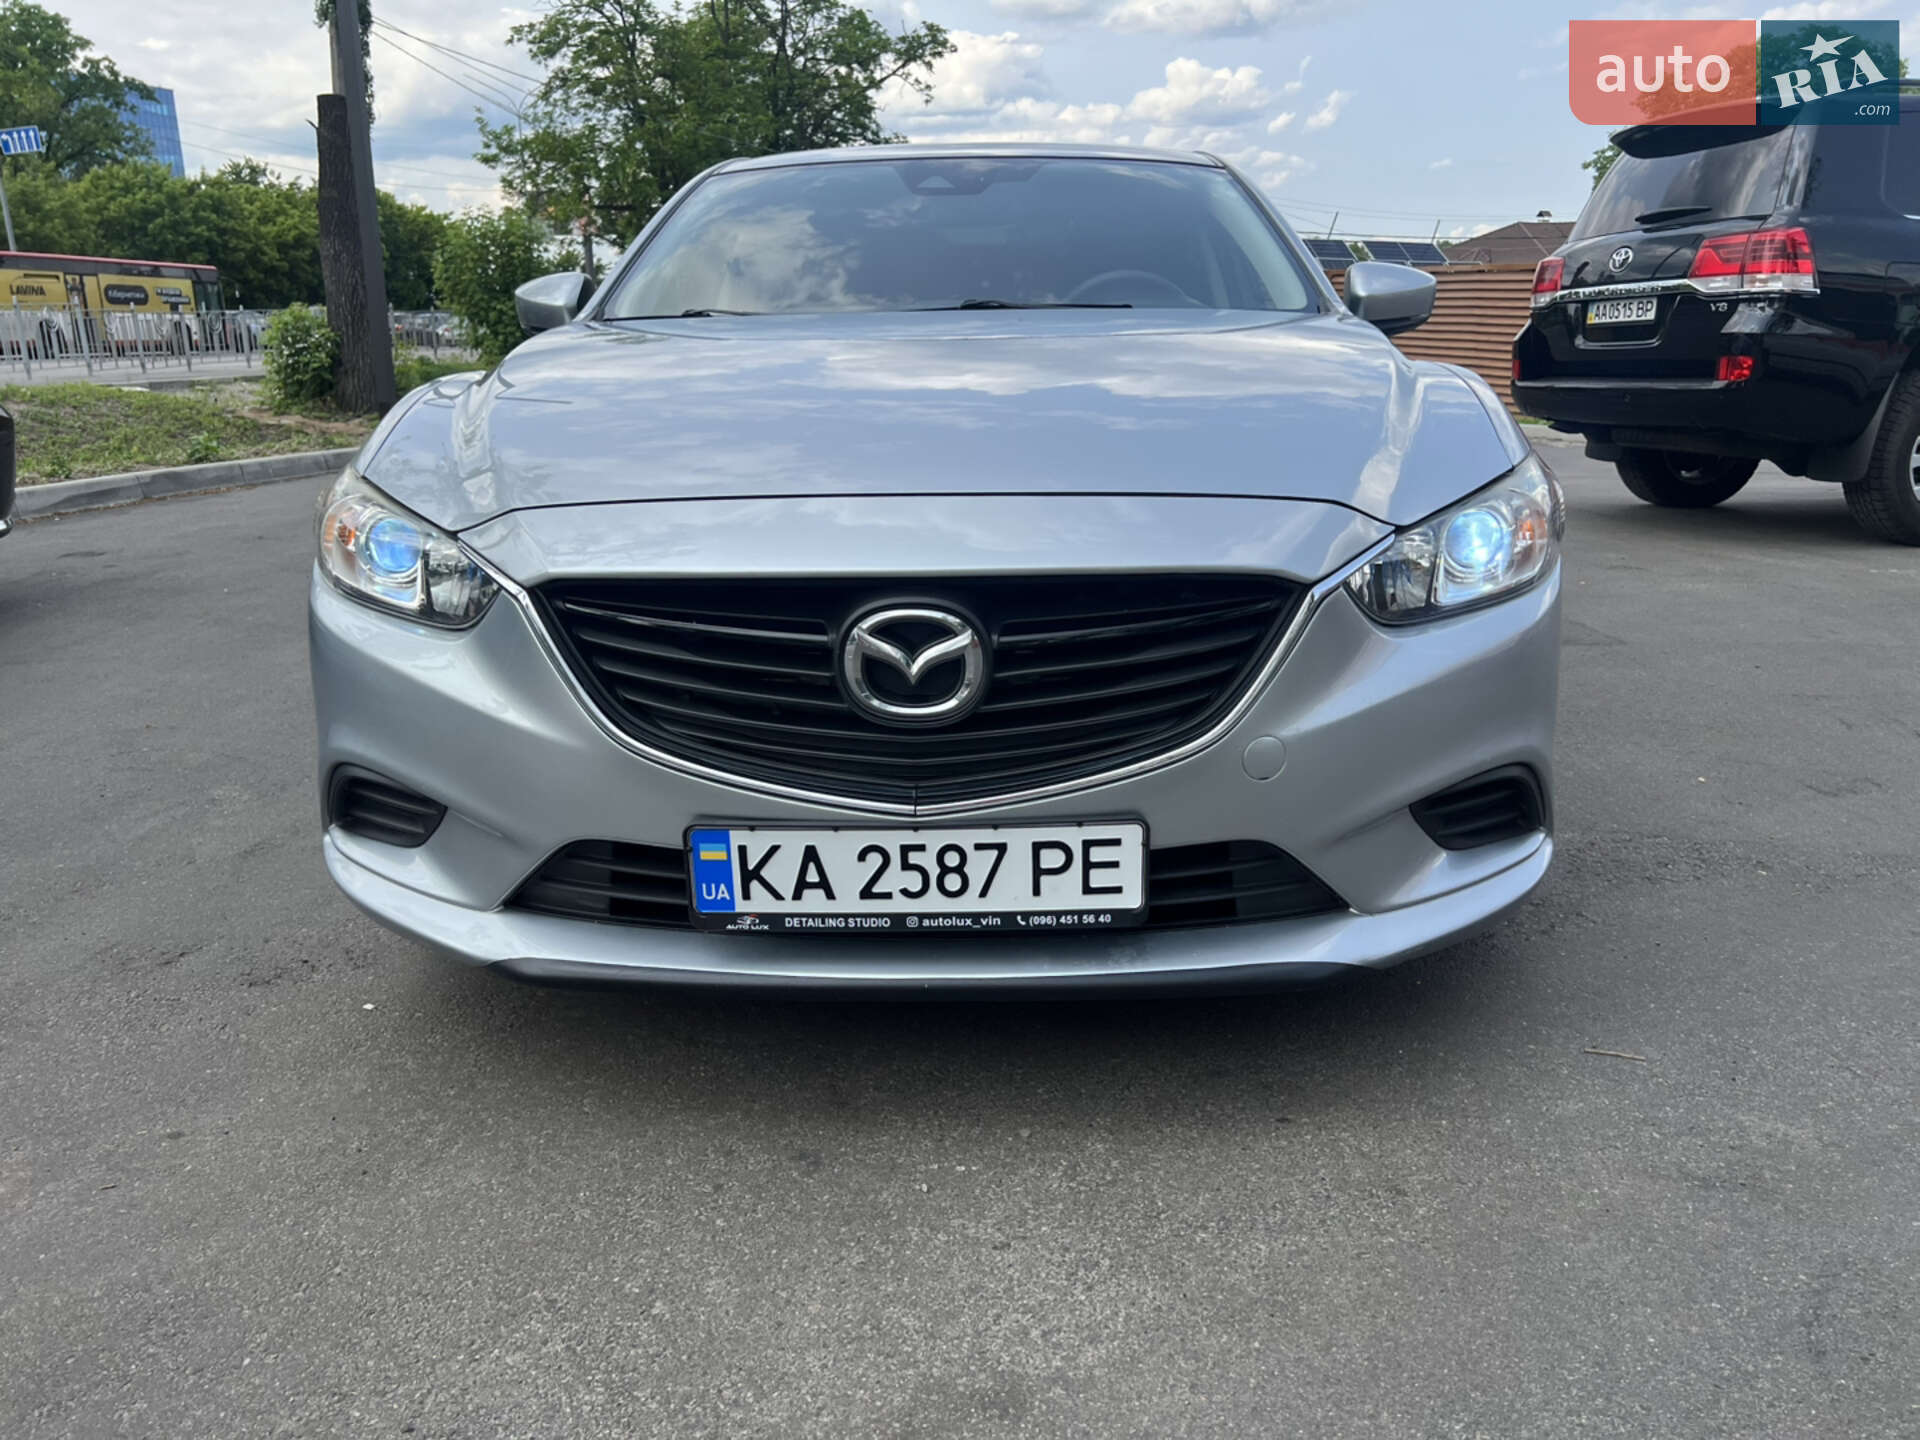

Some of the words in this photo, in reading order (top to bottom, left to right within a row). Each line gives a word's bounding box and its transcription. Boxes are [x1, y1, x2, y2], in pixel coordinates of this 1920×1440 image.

[737, 844, 837, 901] KA
[857, 842, 1008, 902] 2587
[1031, 838, 1123, 897] PE
[702, 883, 730, 900] UA
[784, 917, 846, 928] DETAILING
[847, 917, 891, 928] STUDIO
[922, 915, 1001, 928] autolux_vin
[1028, 915, 1057, 927] (096)
[1059, 914, 1079, 925] 451
[1081, 914, 1096, 924] 56
[1097, 913, 1112, 924] 40
